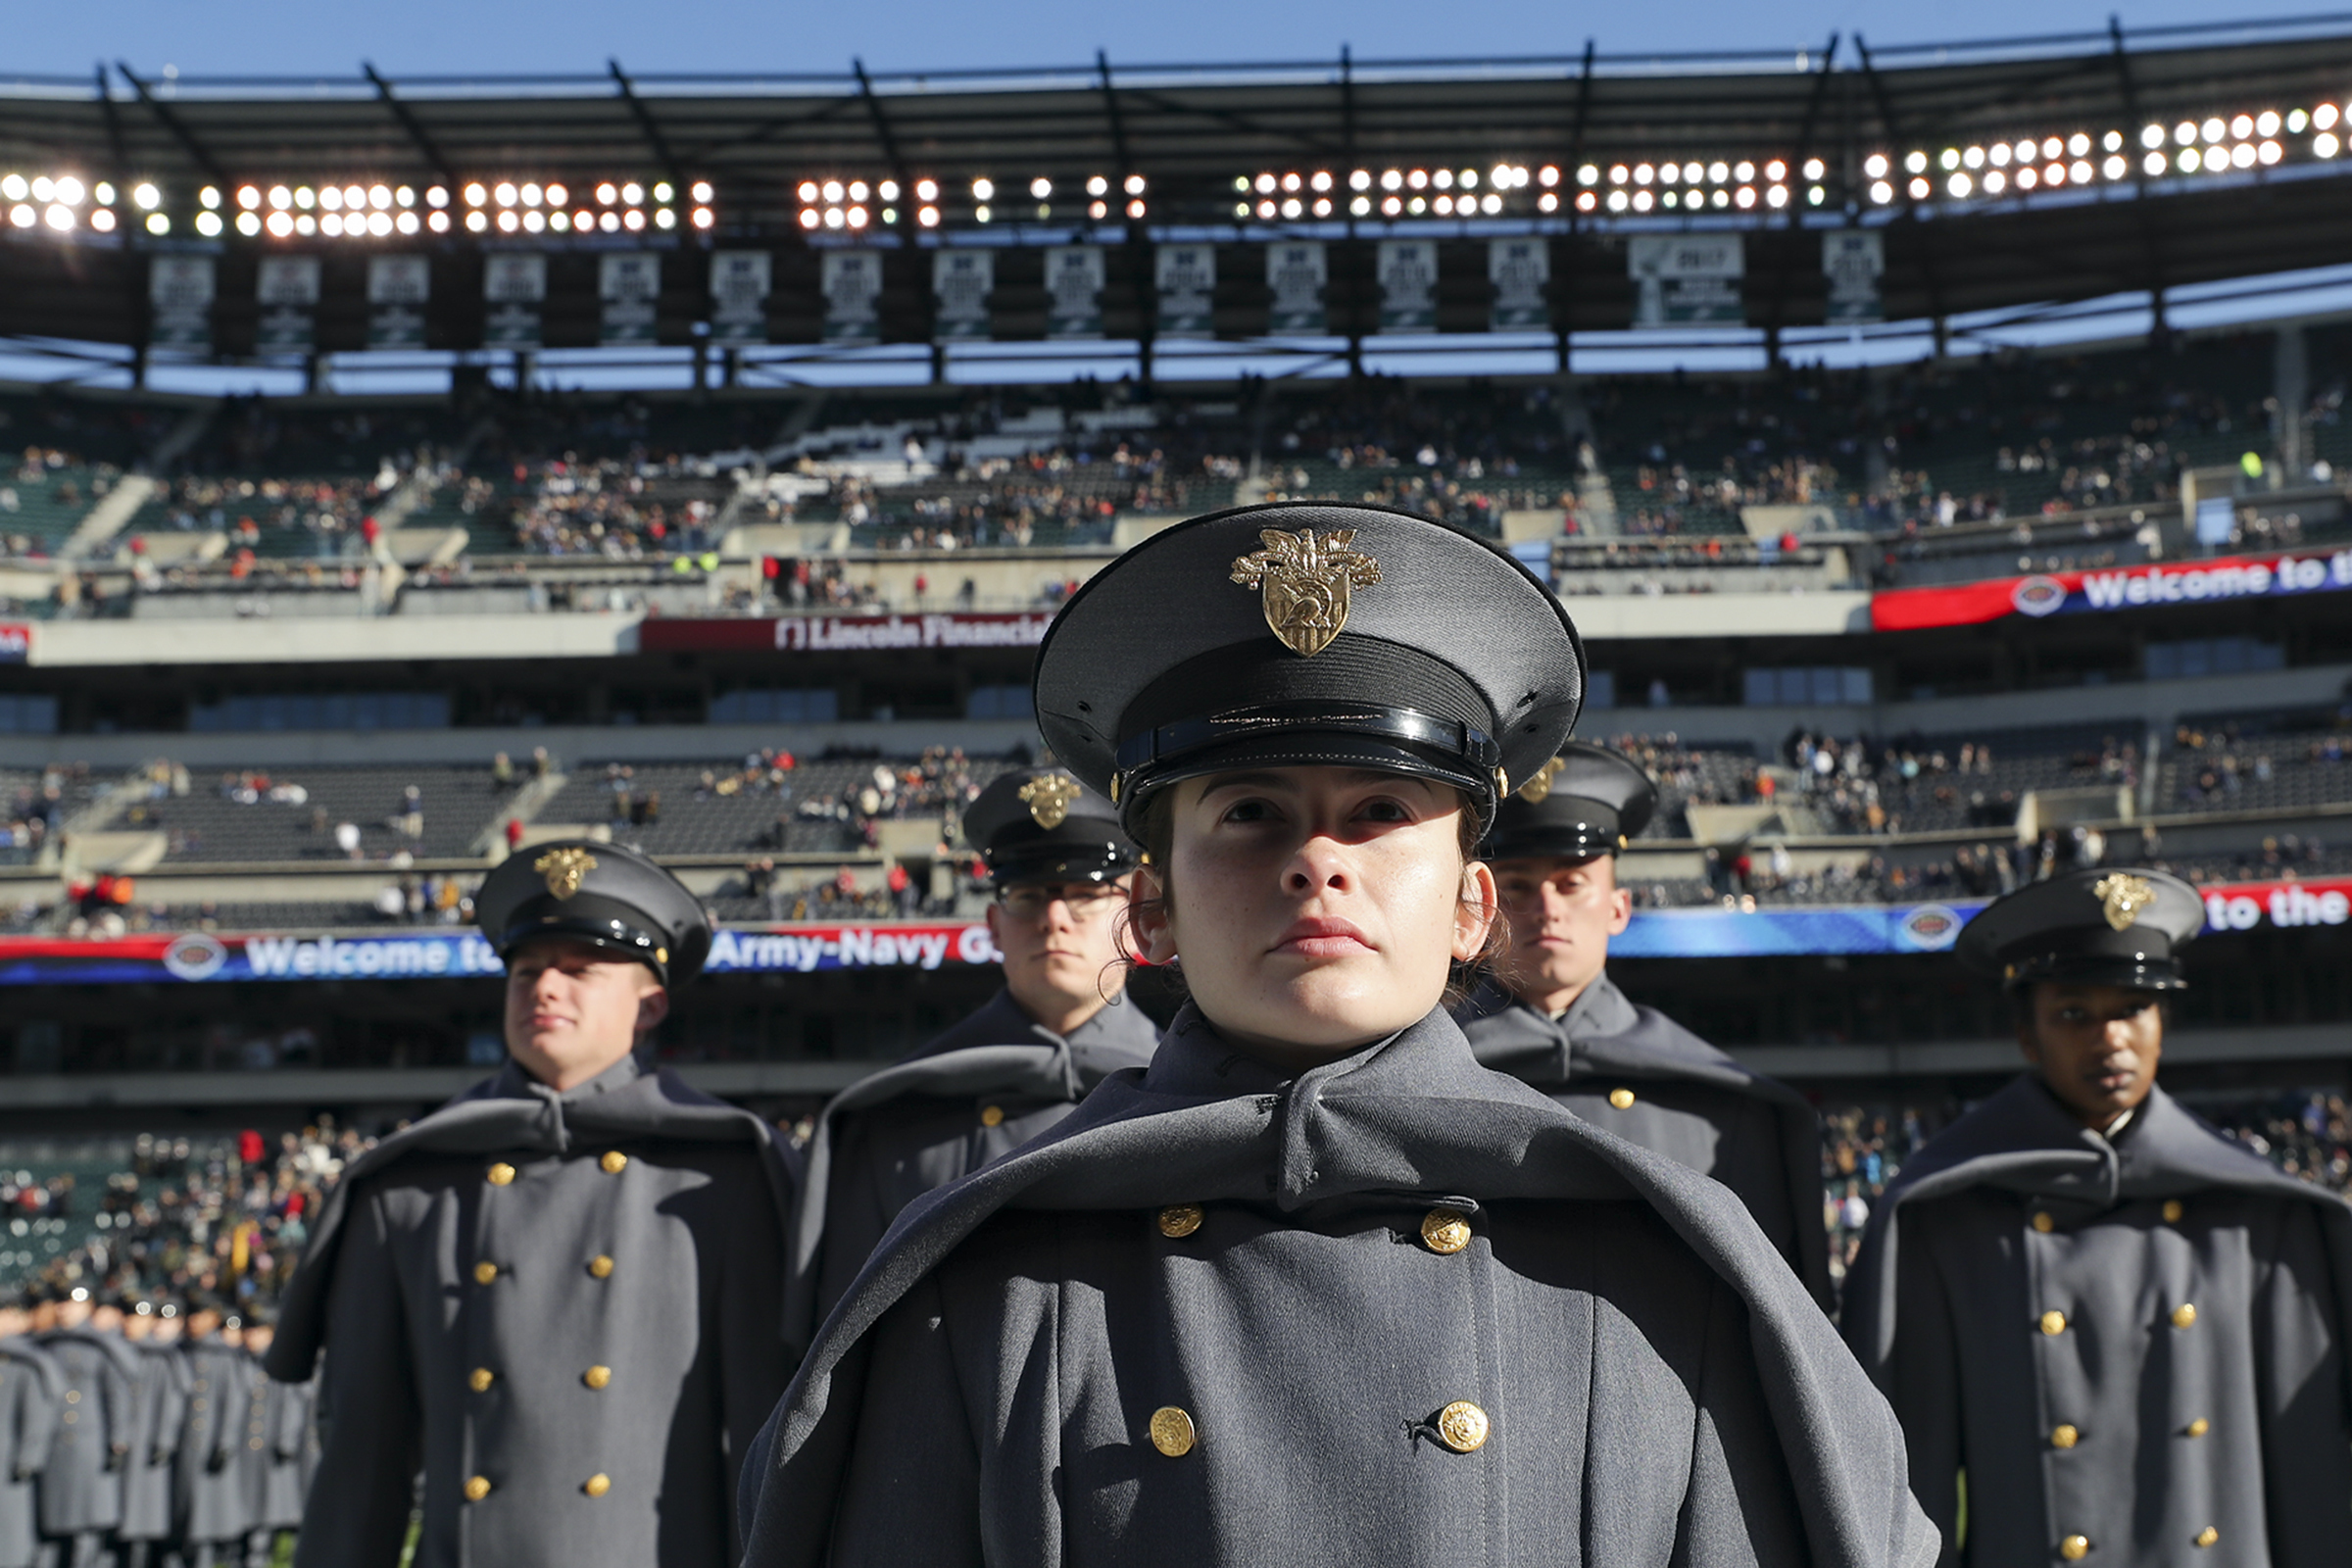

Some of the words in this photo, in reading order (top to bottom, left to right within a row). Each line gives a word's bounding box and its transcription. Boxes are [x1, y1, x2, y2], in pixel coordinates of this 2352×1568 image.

[2083, 563, 2271, 607] Welcome
[2278, 556, 2327, 590] to
[809, 615, 920, 649] Lincoln
[2207, 893, 2260, 930] to
[2269, 885, 2350, 927] the
[246, 935, 450, 975] Welcome
[460, 934, 503, 972] to
[710, 927, 949, 971] Army-Navy
